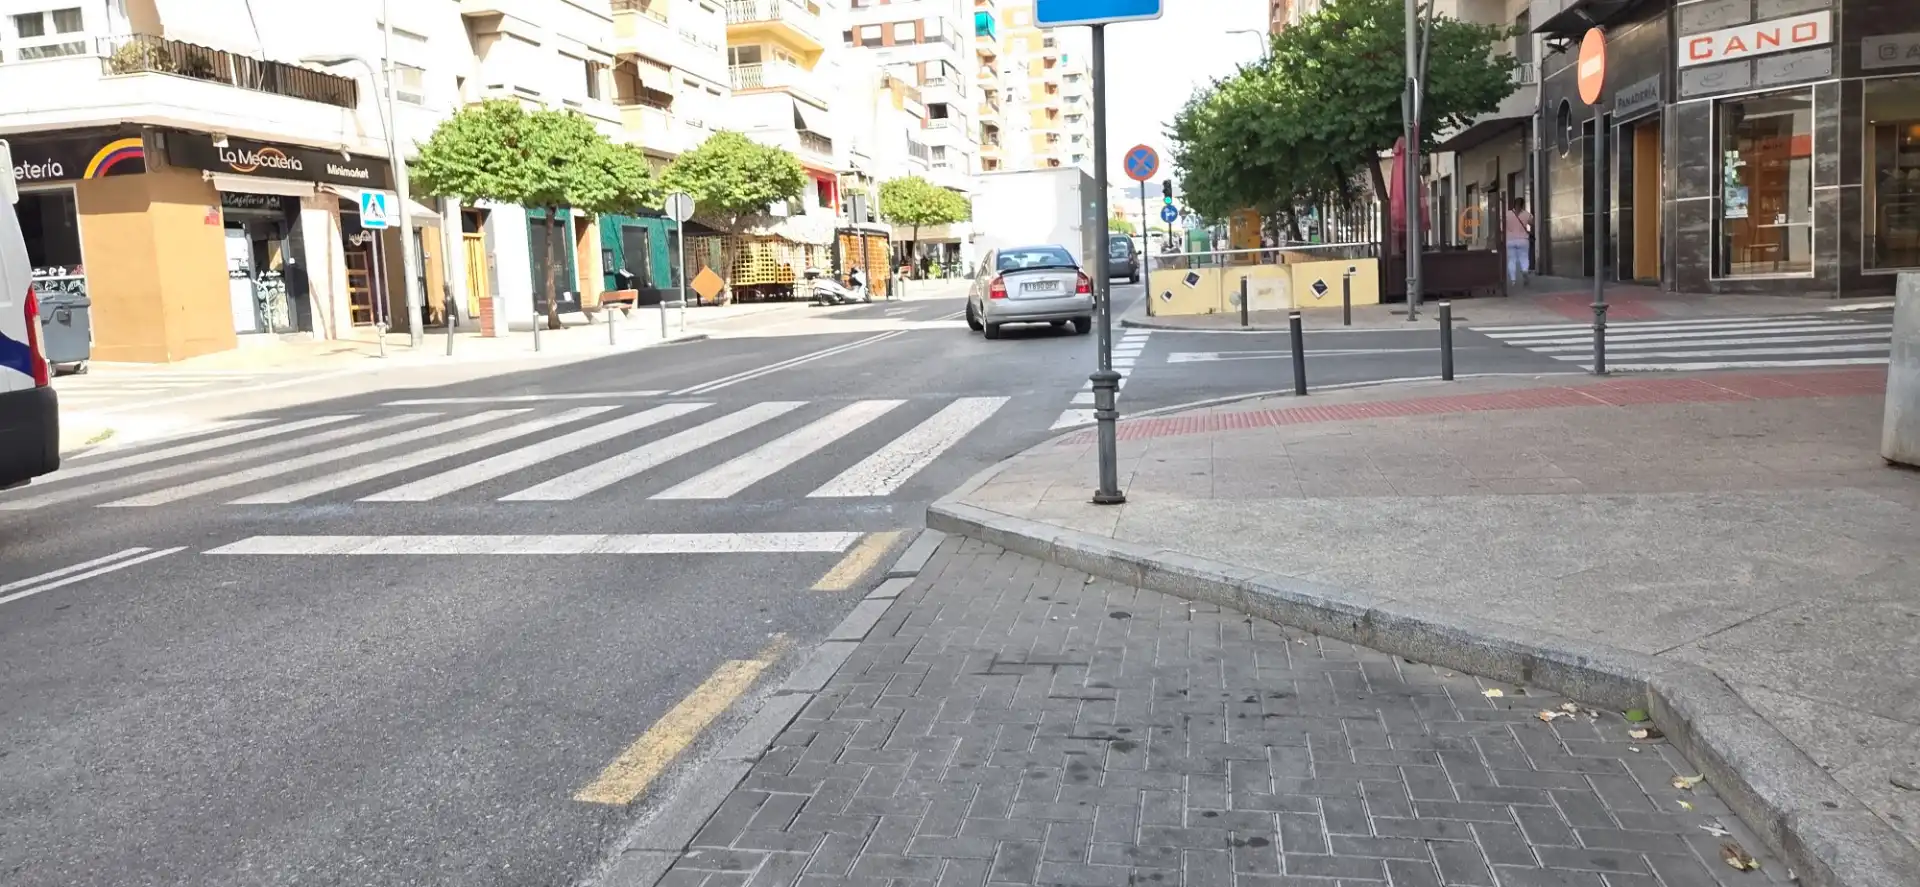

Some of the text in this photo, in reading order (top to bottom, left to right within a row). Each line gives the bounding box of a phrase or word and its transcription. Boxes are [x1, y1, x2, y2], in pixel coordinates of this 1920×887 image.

[1689, 21, 1818, 60] CANO
[219, 147, 237, 163] La
[327, 163, 369, 179] Minimarket
